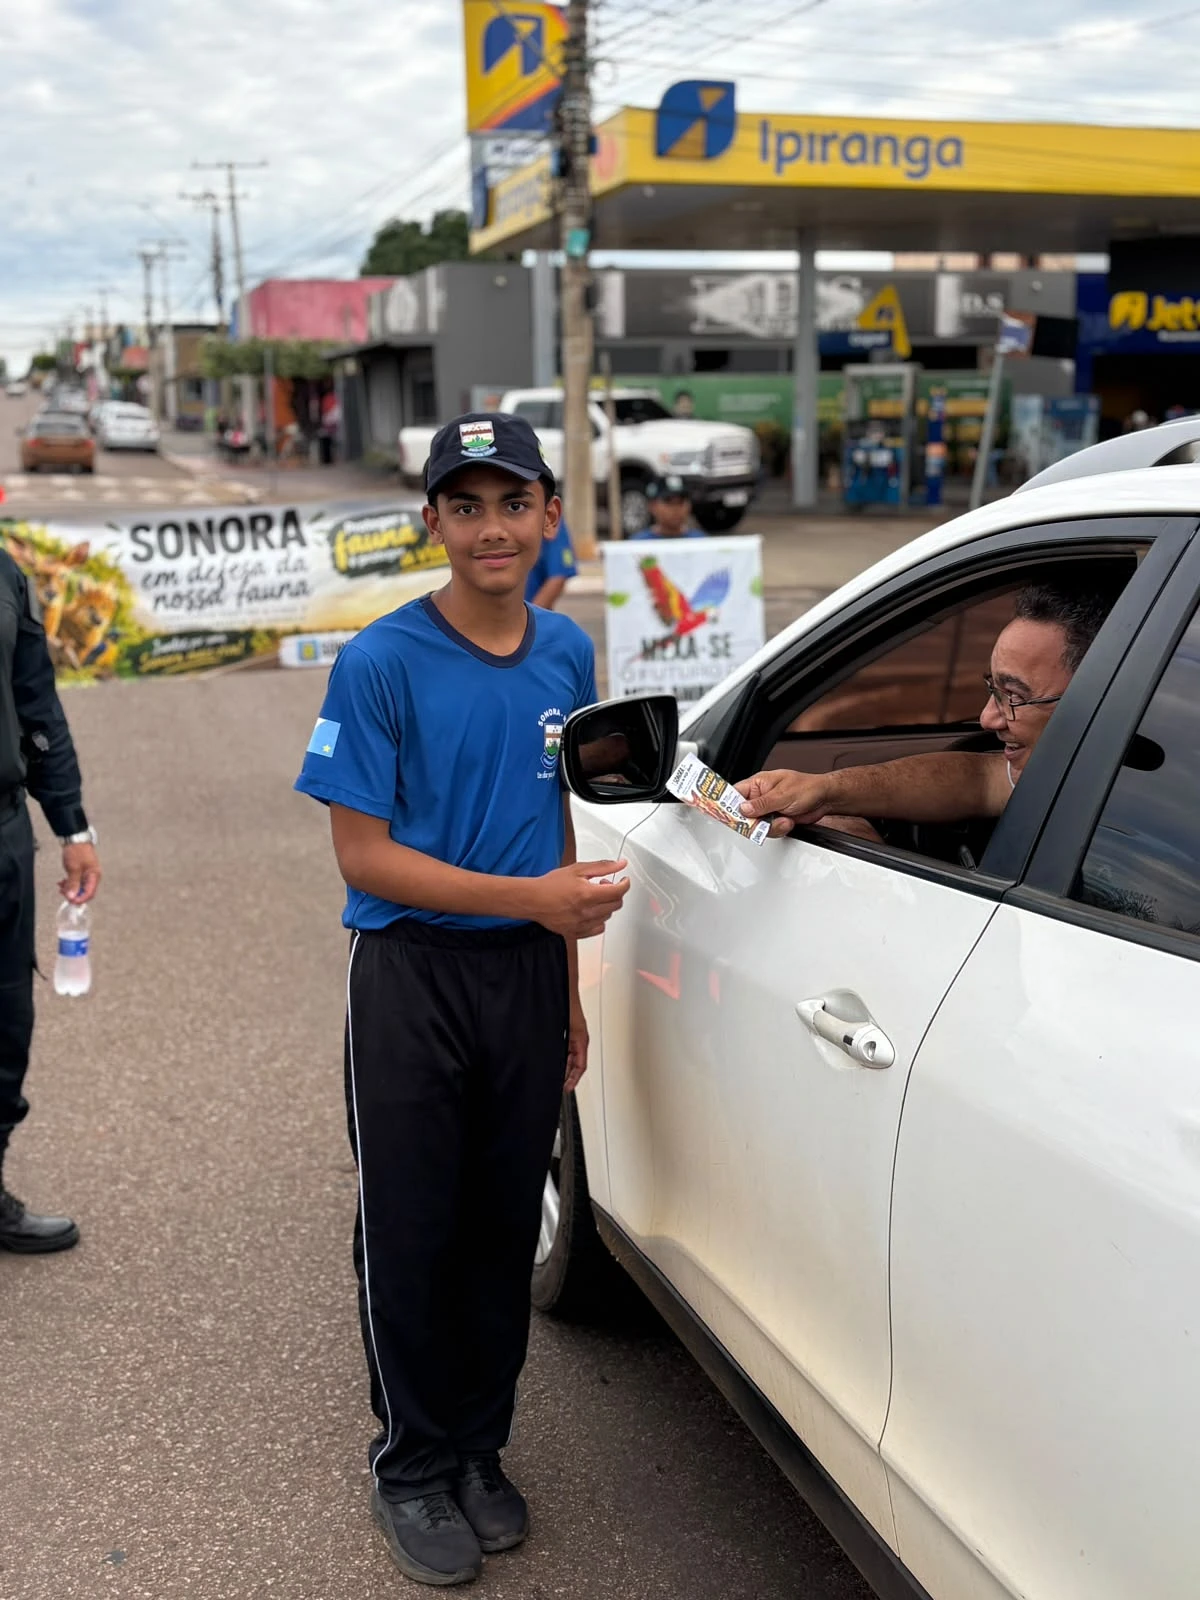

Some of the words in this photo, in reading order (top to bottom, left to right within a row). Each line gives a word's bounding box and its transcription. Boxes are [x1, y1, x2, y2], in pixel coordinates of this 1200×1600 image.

[758, 118, 964, 179] Ipiranga
[130, 508, 306, 562] SONORA
[142, 569, 178, 590] em
[187, 556, 266, 589] defesa
[277, 552, 308, 574] da
[153, 587, 223, 611] nossa
[238, 578, 311, 607] fauna
[538, 707, 560, 727] SONORA
